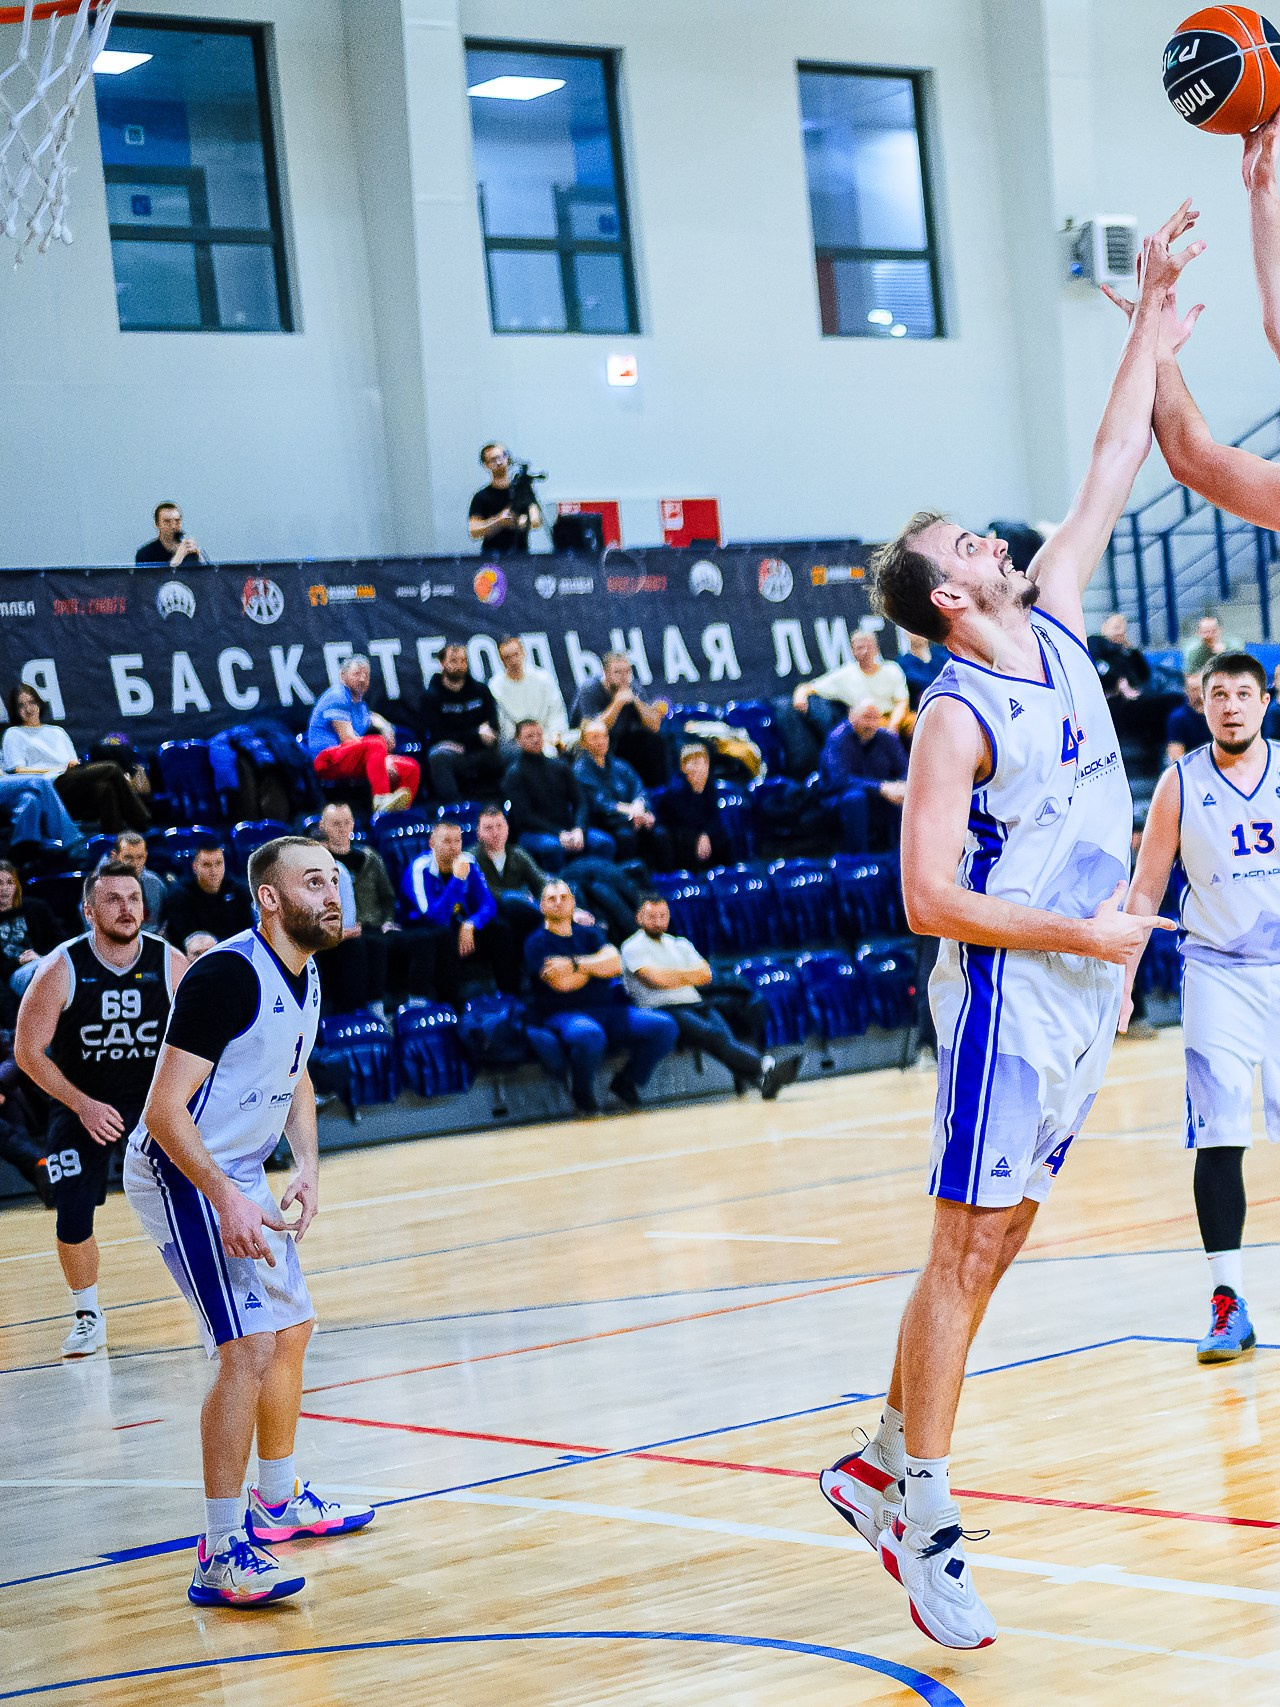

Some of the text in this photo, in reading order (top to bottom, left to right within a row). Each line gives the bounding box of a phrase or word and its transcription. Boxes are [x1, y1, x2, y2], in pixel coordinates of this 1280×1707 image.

[0, 657, 66, 723] Я
[771, 614, 911, 678] ЛИ
[1060, 712, 1087, 767] 4
[1229, 819, 1278, 859] 13
[101, 988, 142, 1020] 69
[80, 1021, 159, 1047] СДС
[81, 1046, 157, 1061] УГОЛЬ
[288, 1031, 305, 1078] 1
[47, 1148, 82, 1184] 69
[1042, 1131, 1076, 1178] 4
[990, 1168, 1013, 1178] PEAK
[905, 1466, 934, 1478] ILA
